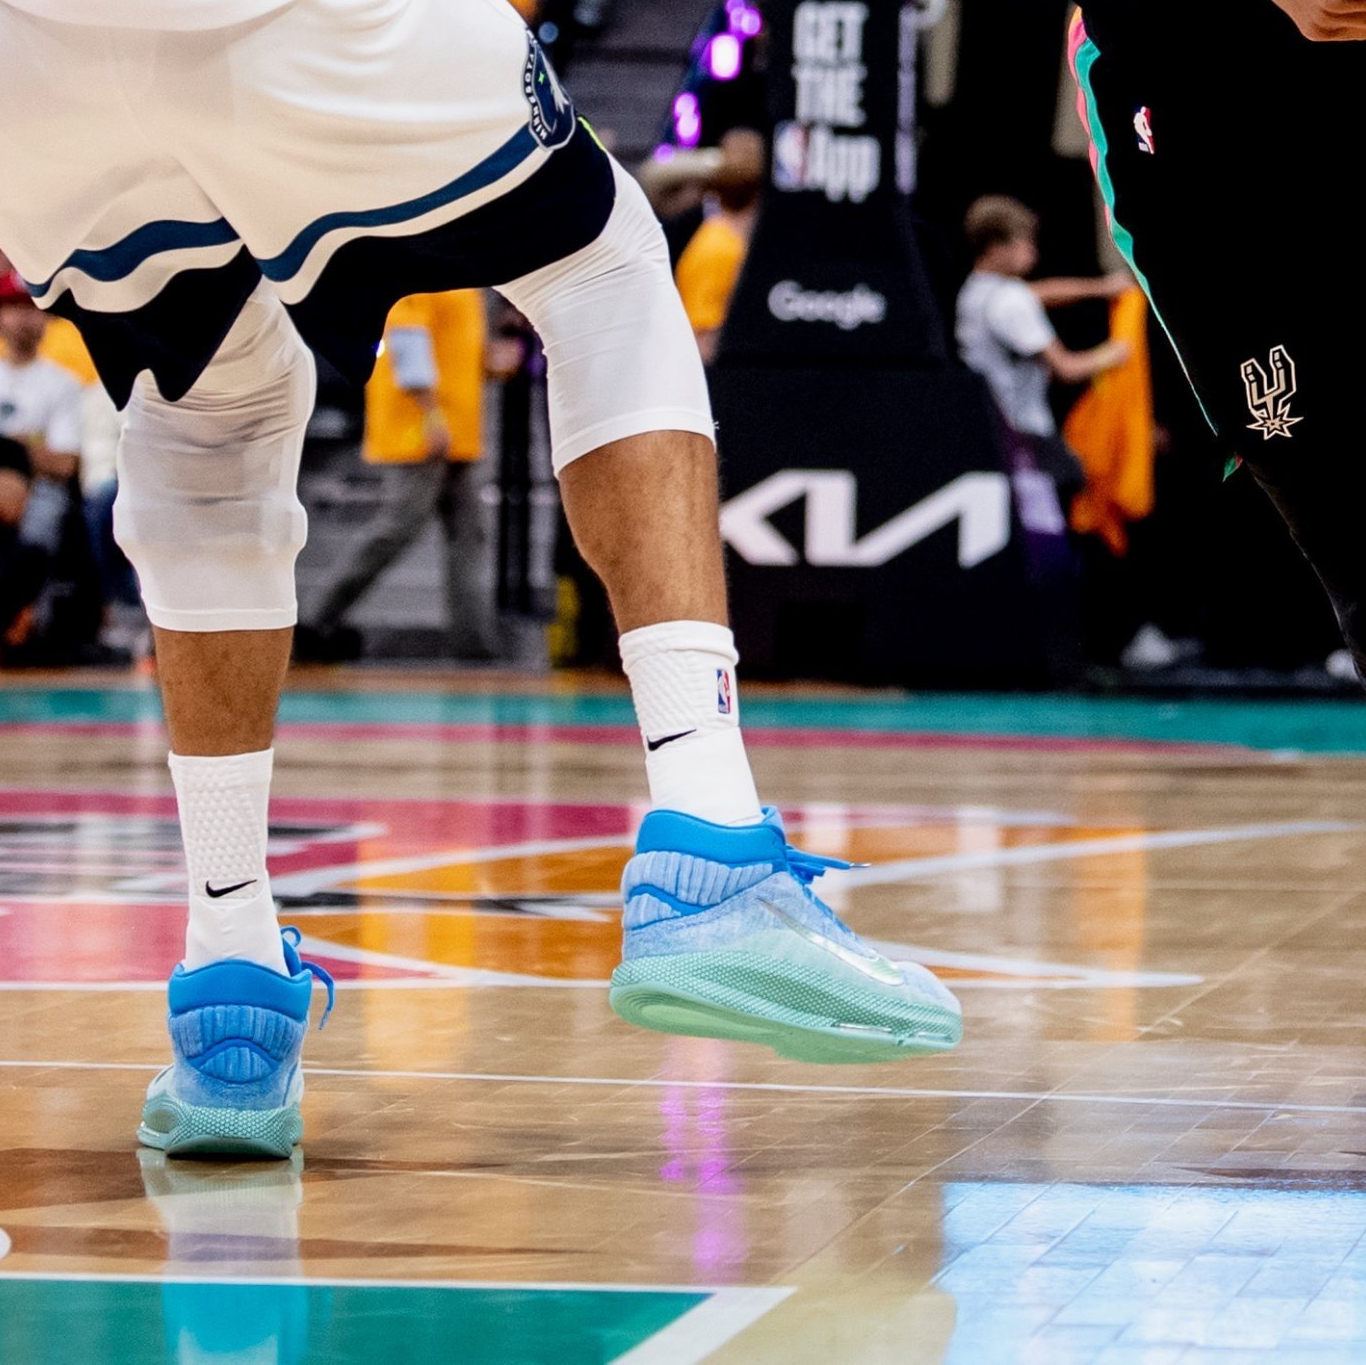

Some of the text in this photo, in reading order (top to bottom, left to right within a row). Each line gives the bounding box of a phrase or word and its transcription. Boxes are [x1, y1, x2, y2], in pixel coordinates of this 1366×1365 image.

[792, 0, 870, 61] GET
[791, 62, 868, 127] THE
[767, 279, 887, 331] Google
